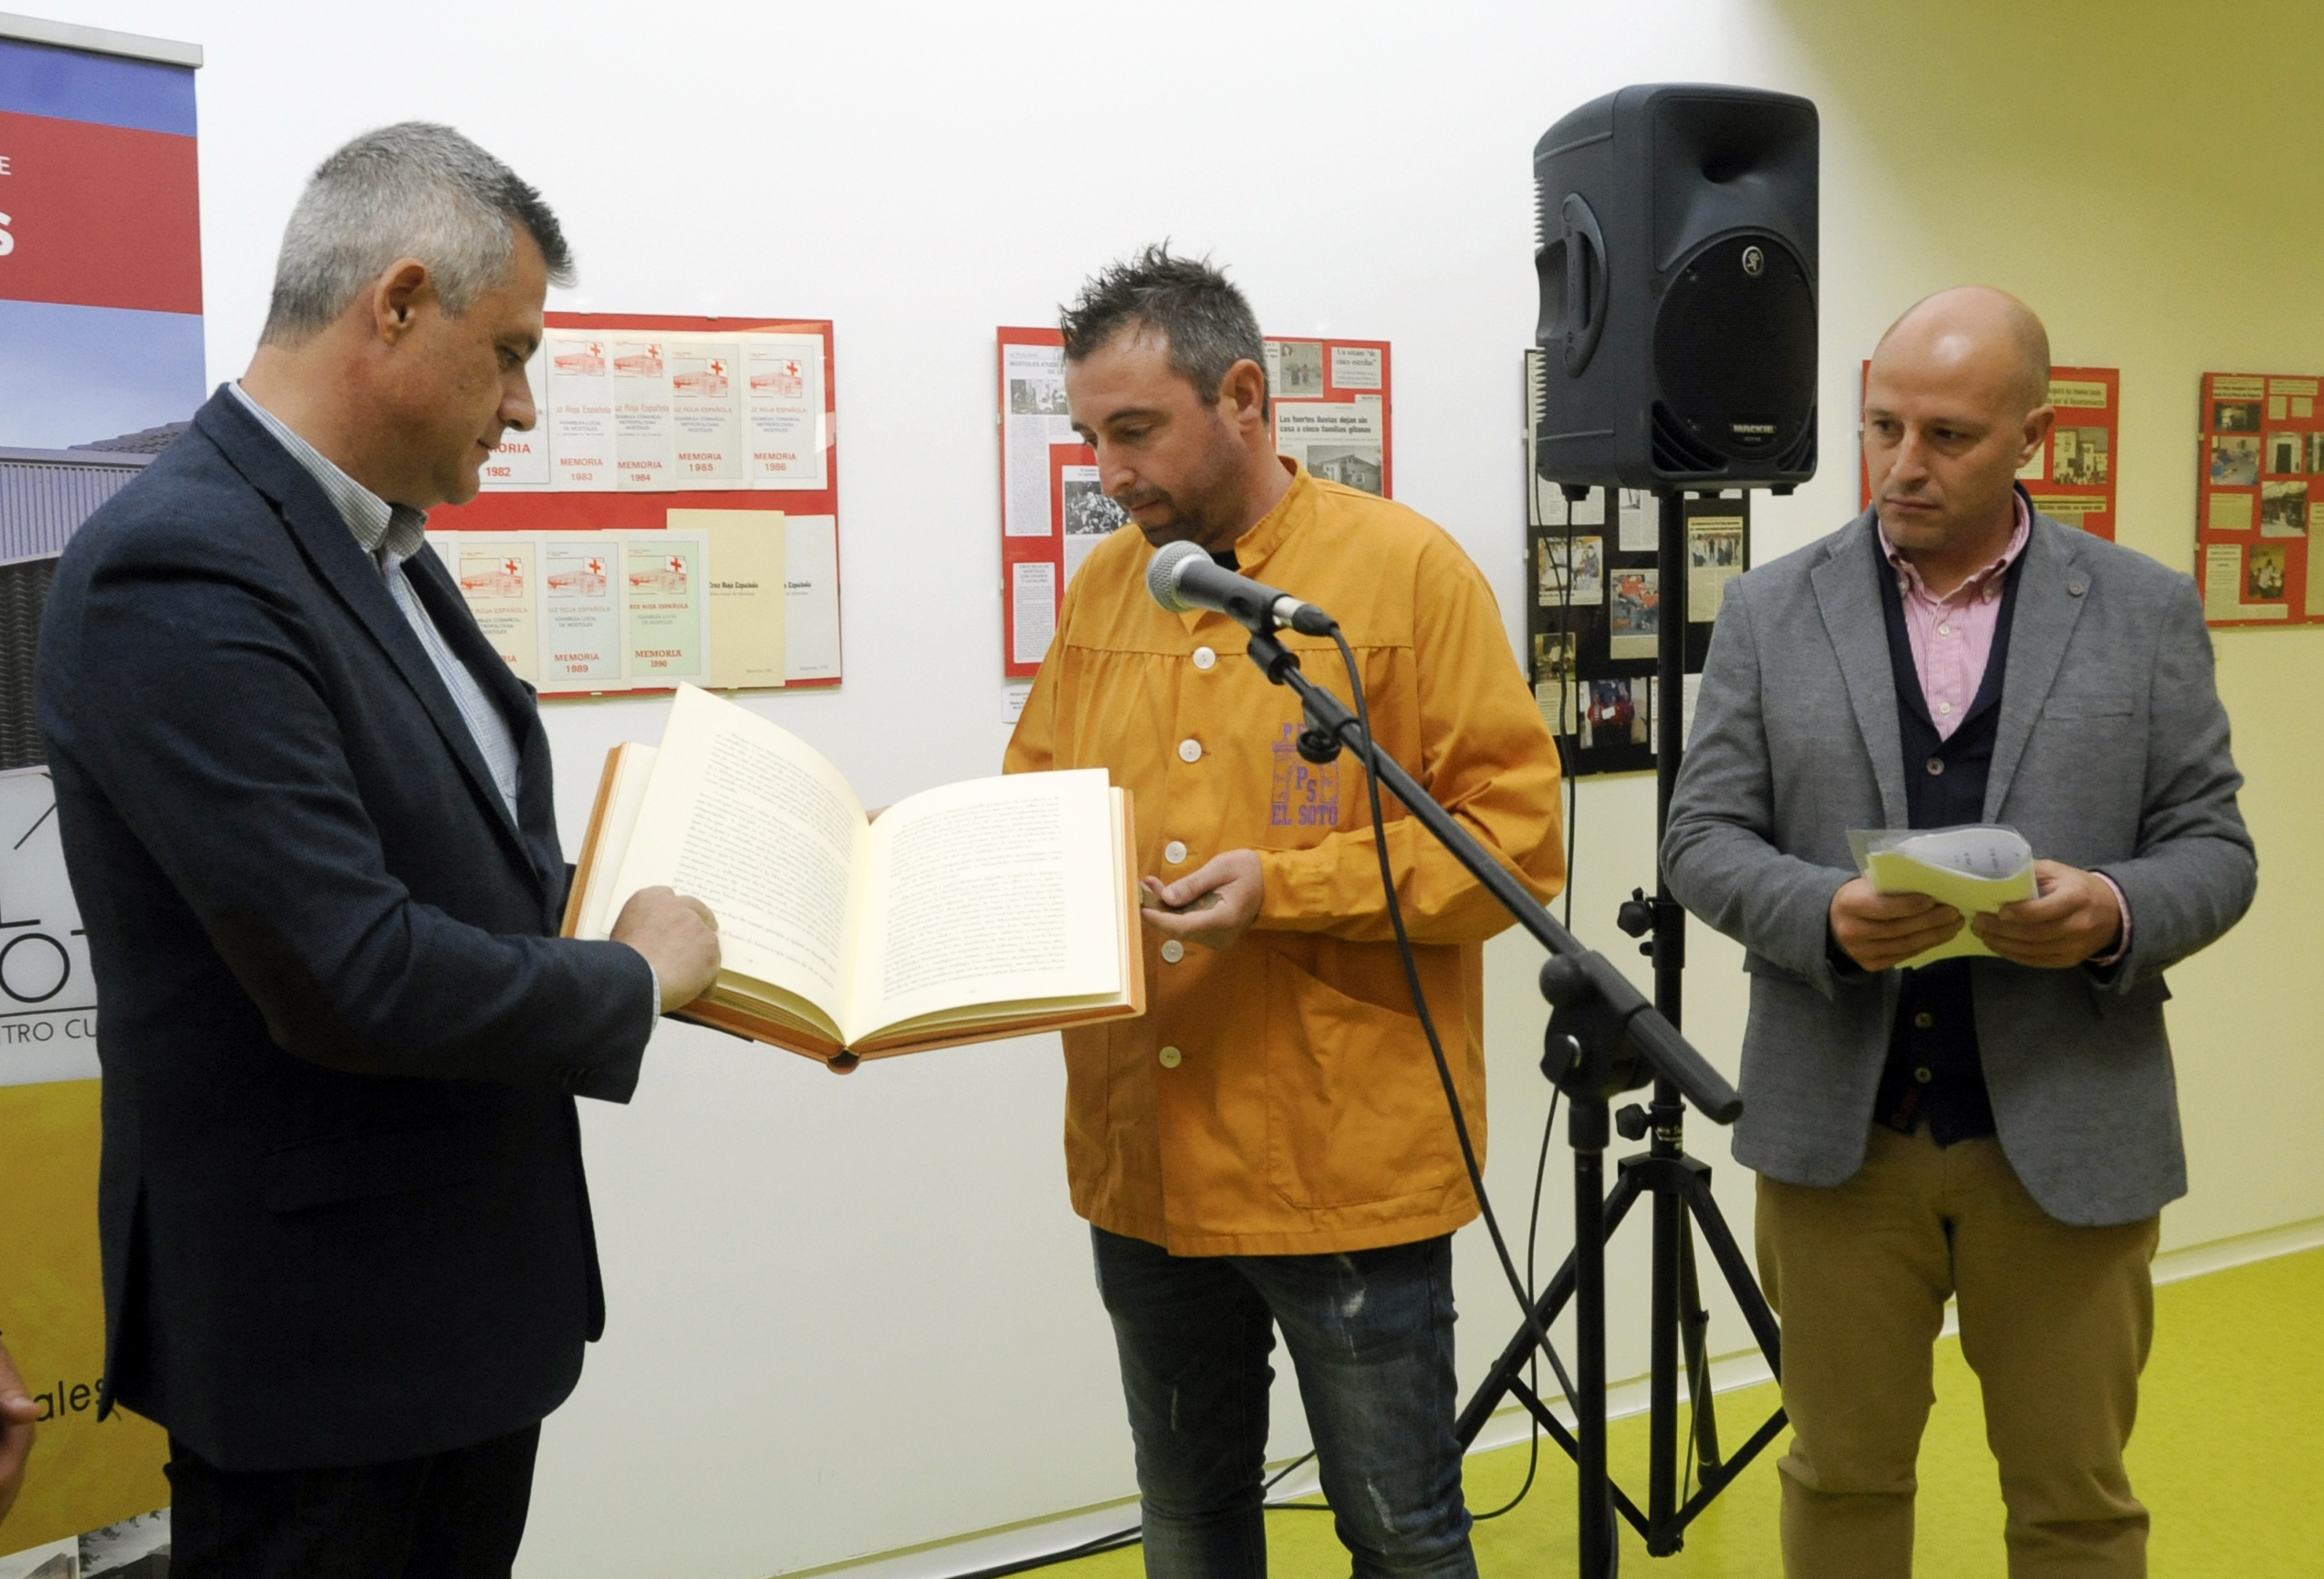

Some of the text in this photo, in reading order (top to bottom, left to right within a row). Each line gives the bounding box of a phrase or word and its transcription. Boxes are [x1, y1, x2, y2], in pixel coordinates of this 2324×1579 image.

[1279, 415, 1291, 423] Las
[1339, 416, 1357, 425] dejan
[678, 452, 723, 461] MEMORIA
[754, 452, 797, 461] MEMORIA
[559, 458, 604, 466] MEMORIA
[617, 461, 663, 470] MEMORIA
[485, 466, 512, 477] 1982
[689, 462, 714, 472] 1985
[570, 473, 594, 482] 1983
[555, 653, 599, 661] MEMORIA
[635, 649, 682, 658] MEMORIA
[1271, 805, 1339, 826] EL SOTO
